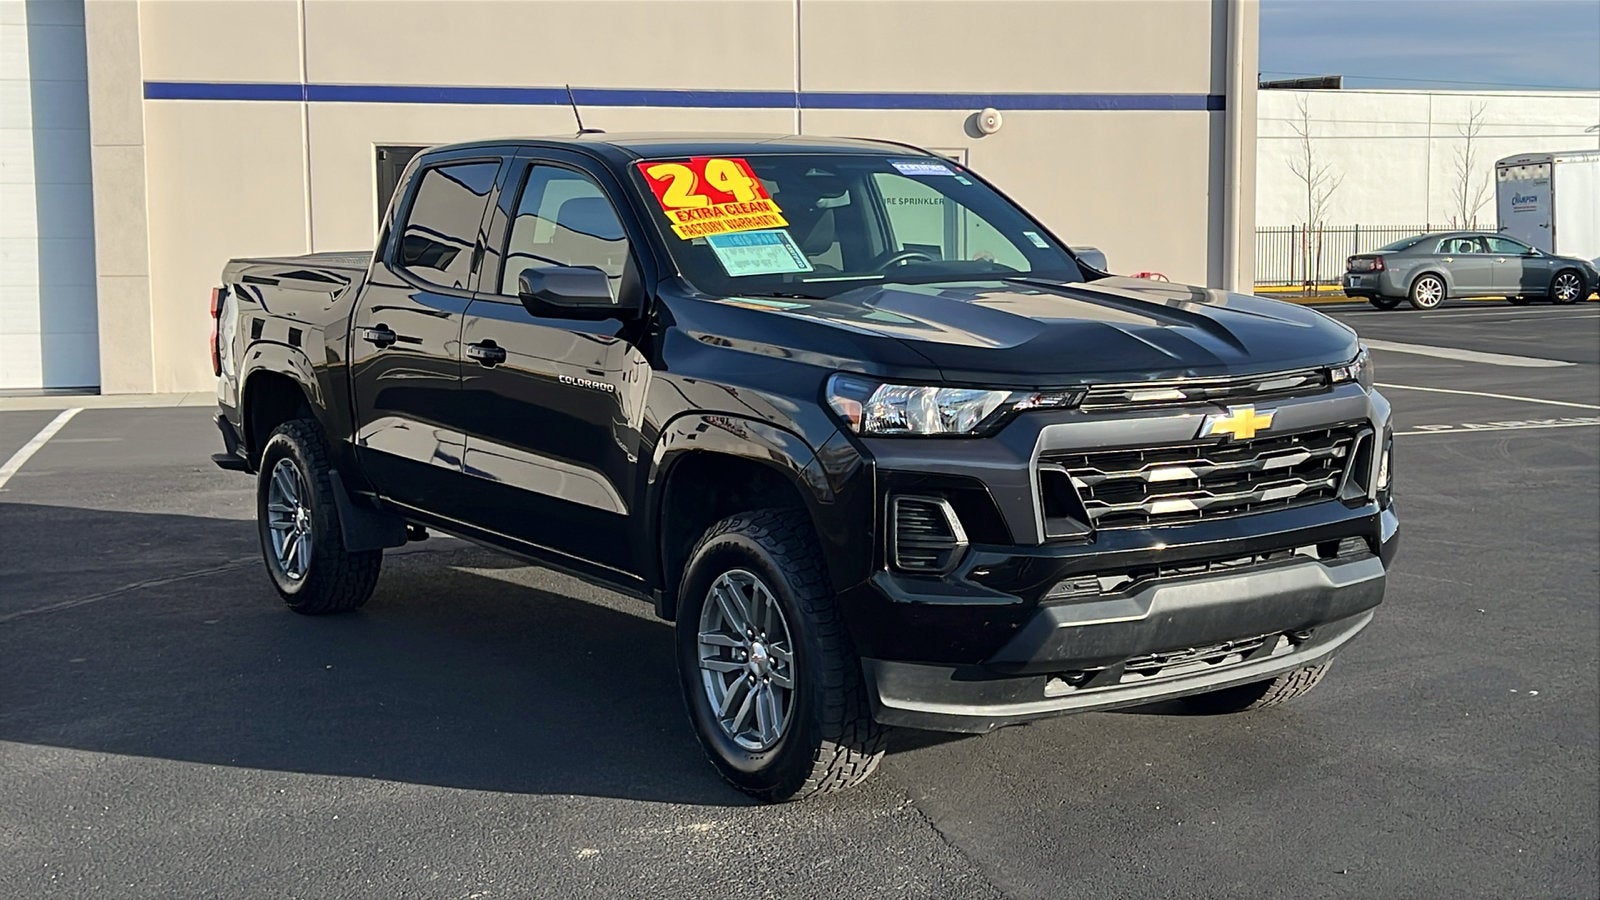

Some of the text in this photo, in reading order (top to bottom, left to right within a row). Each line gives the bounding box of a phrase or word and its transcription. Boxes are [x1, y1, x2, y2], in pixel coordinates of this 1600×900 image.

[647, 158, 761, 208] 24
[674, 200, 771, 222] EXTRA CLEAN
[898, 197, 945, 205] SPRINKLER
[679, 214, 780, 236] FACTORY WARRANTY
[558, 374, 614, 393] COLORADO
